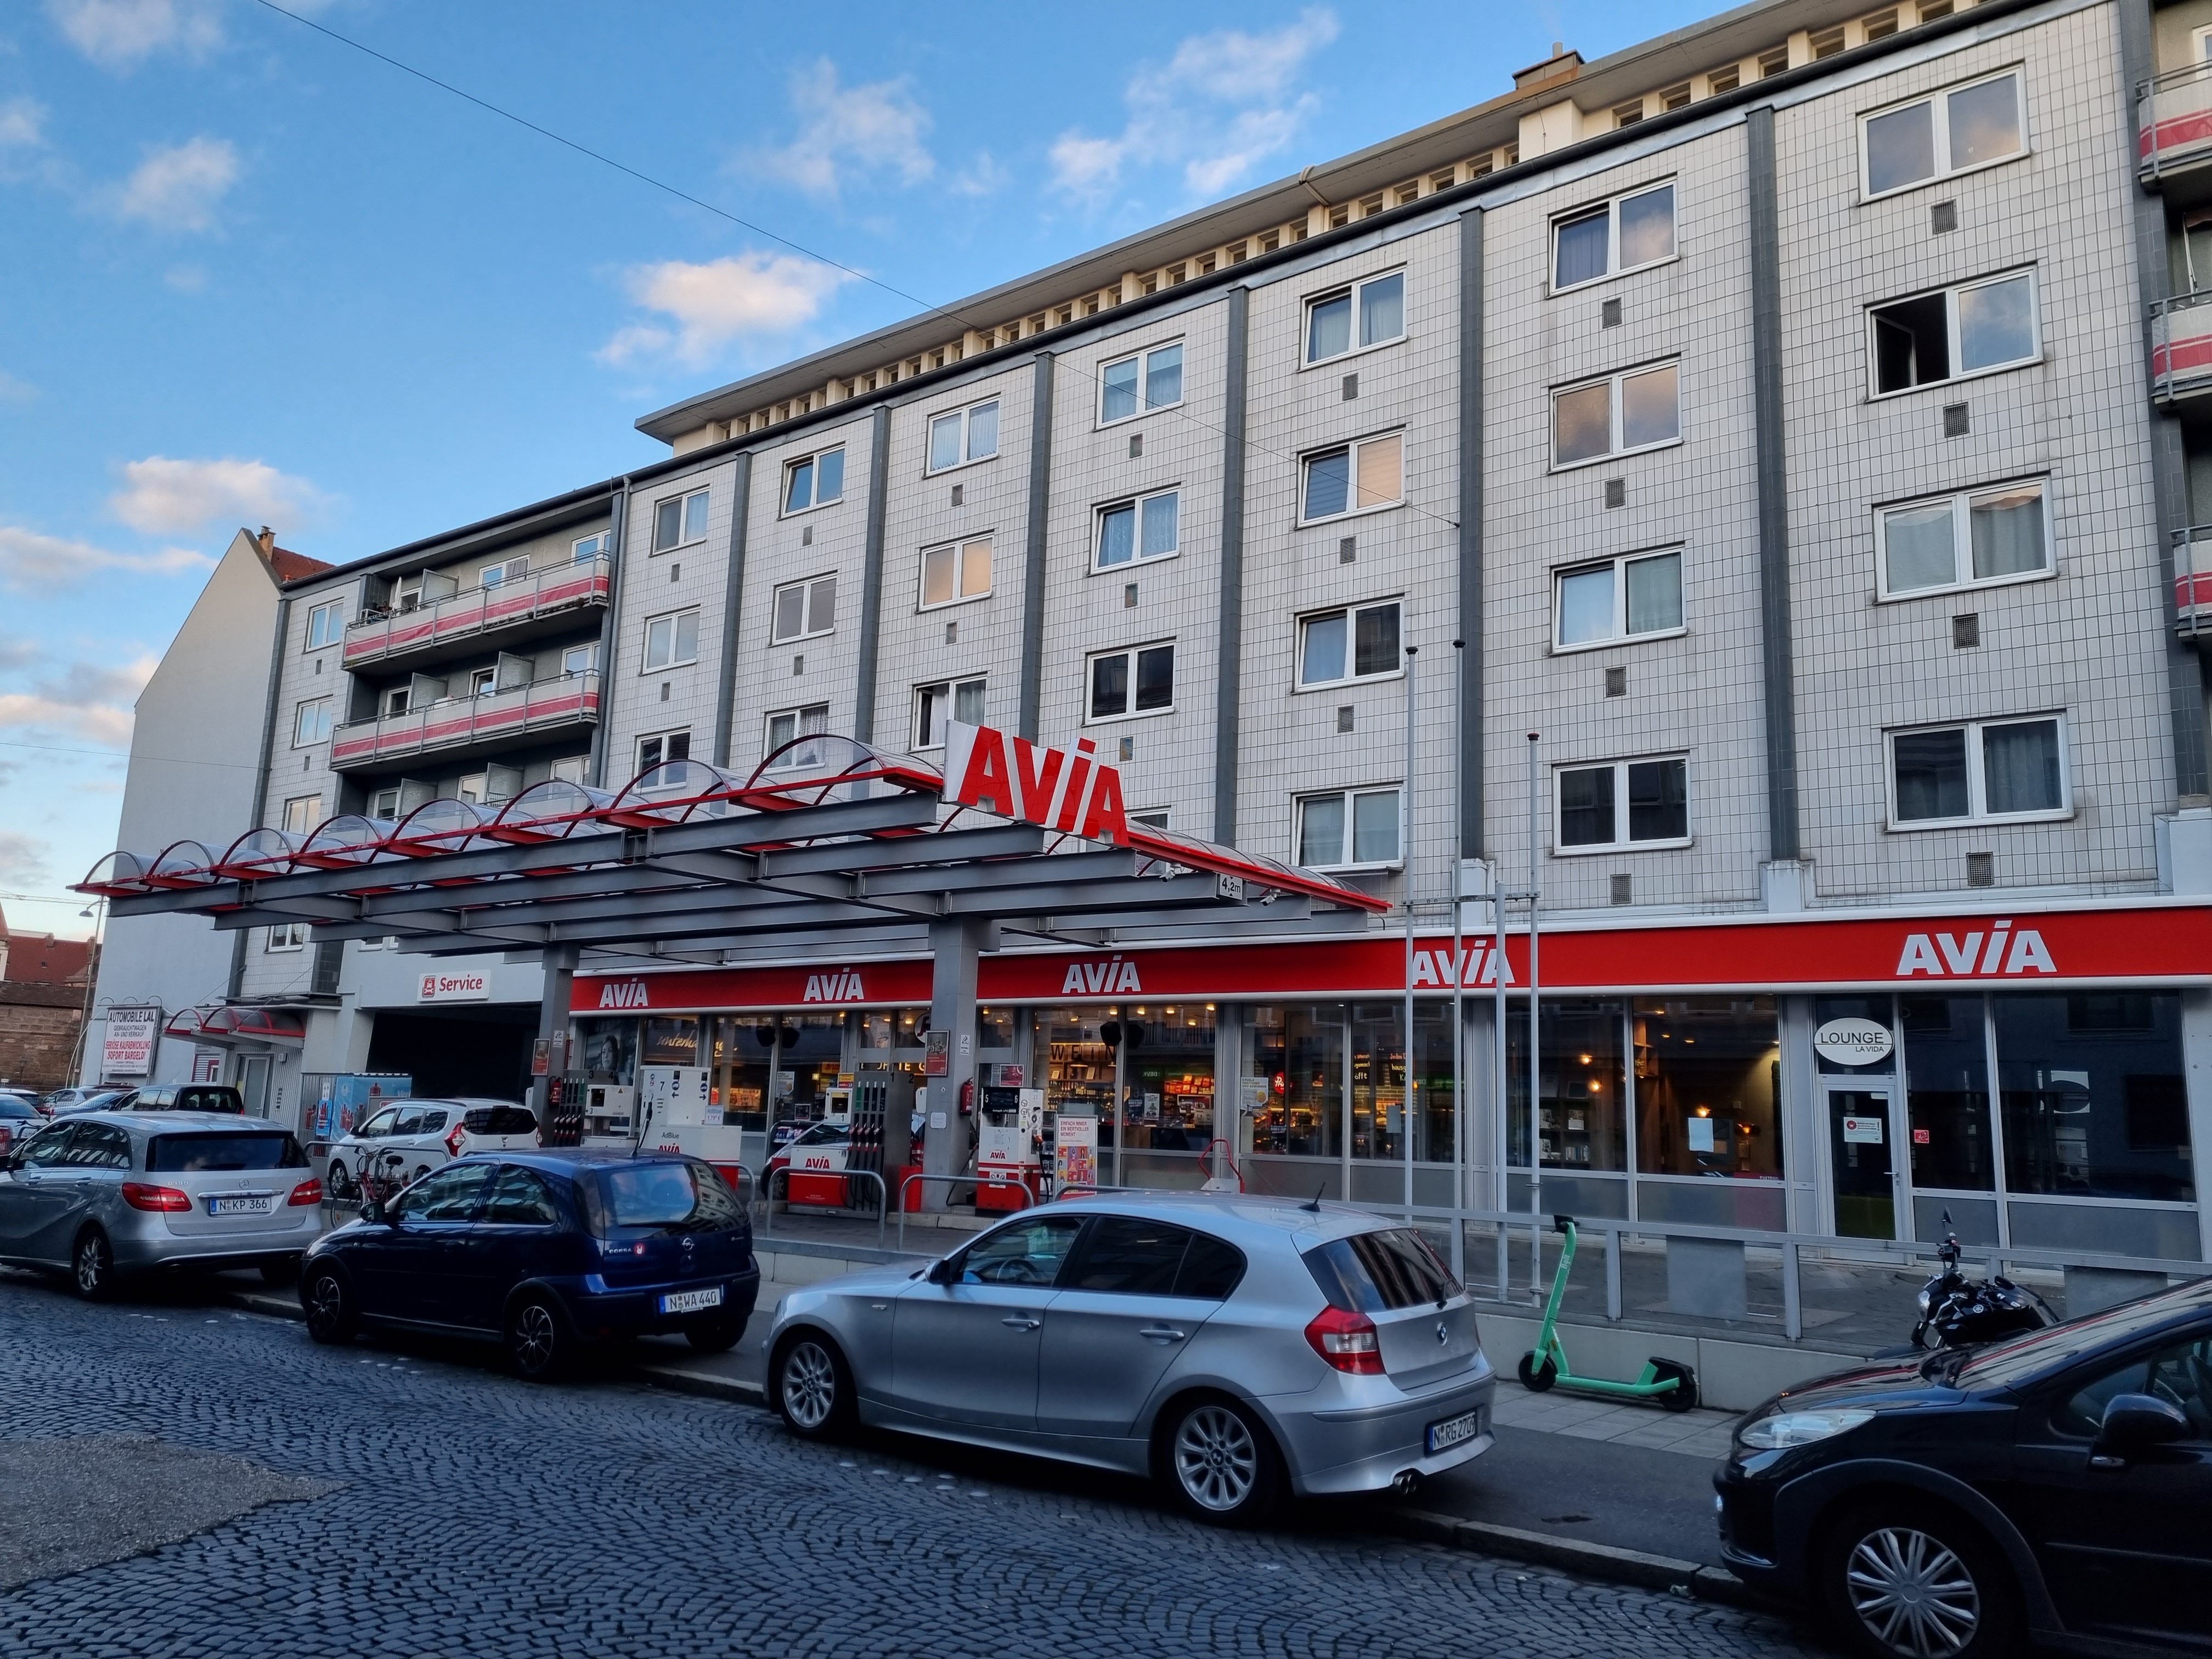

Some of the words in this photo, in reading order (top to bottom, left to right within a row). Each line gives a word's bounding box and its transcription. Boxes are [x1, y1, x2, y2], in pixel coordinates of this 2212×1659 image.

[958, 725, 1130, 848] AVIA
[1222, 878, 1240, 893] 4,2m
[1896, 920, 2058, 975] AVIA
[1413, 940, 1515, 985] AVIA
[1062, 955, 1141, 994] AVIA
[439, 974, 482, 991] Service
[803, 967, 864, 1001] AVIA
[599, 978, 648, 1008] AVIA
[109, 1011, 143, 1022] AUTOMOBILE
[143, 1011, 154, 1022] LAL
[1821, 1032, 1884, 1043] LOUNGE
[107, 1051, 124, 1060] SOFORT
[125, 1051, 146, 1060] BARGELD!
[588, 1070, 594, 1079] 3
[608, 1071, 614, 1080] 4
[890, 1073, 894, 1082] 1
[909, 1074, 914, 1084] 2
[660, 1081, 665, 1091] 7
[985, 1094, 989, 1103] 5
[1015, 1095, 1018, 1103] 6
[990, 1150, 1006, 1160] AVIA
[805, 1156, 830, 1169] AVIA
[219, 1200, 226, 1211] N
[233, 1200, 245, 1210] KP
[250, 1199, 267, 1209] 366
[1561, 1254, 1570, 1269] Bolt
[670, 1296, 677, 1310] N
[684, 1294, 697, 1307] WA
[699, 1291, 716, 1305] 440
[1434, 1429, 1440, 1448] N
[1445, 1424, 1457, 1443] RG
[1458, 1414, 1475, 1438] 2709
